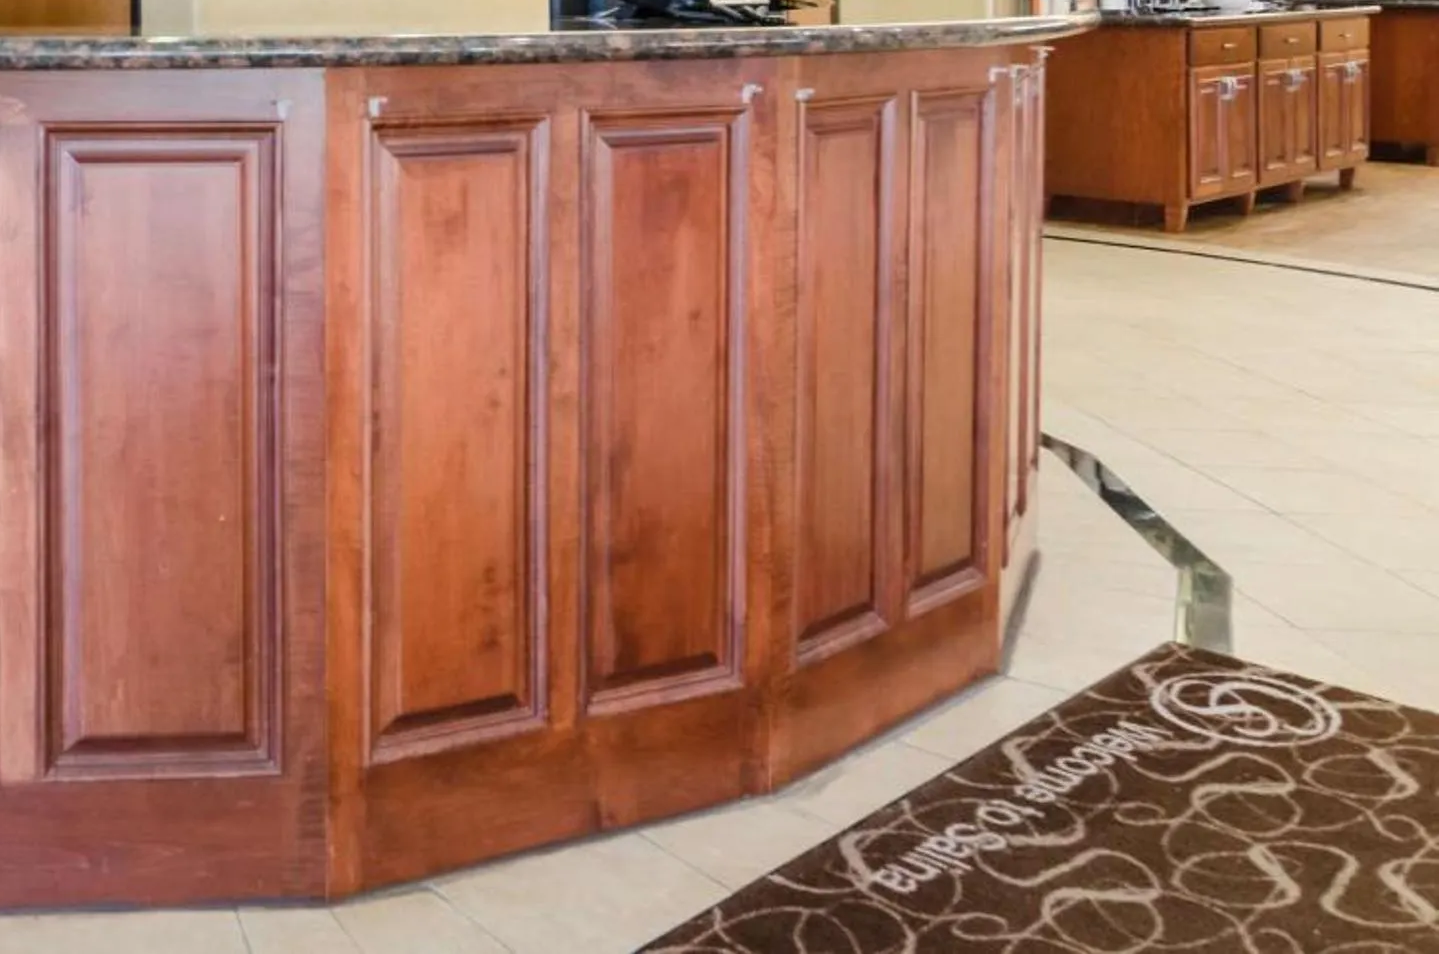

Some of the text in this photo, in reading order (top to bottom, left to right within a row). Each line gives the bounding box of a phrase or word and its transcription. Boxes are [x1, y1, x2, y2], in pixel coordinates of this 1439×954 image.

[872, 720, 1174, 893] Welcome to Salina
